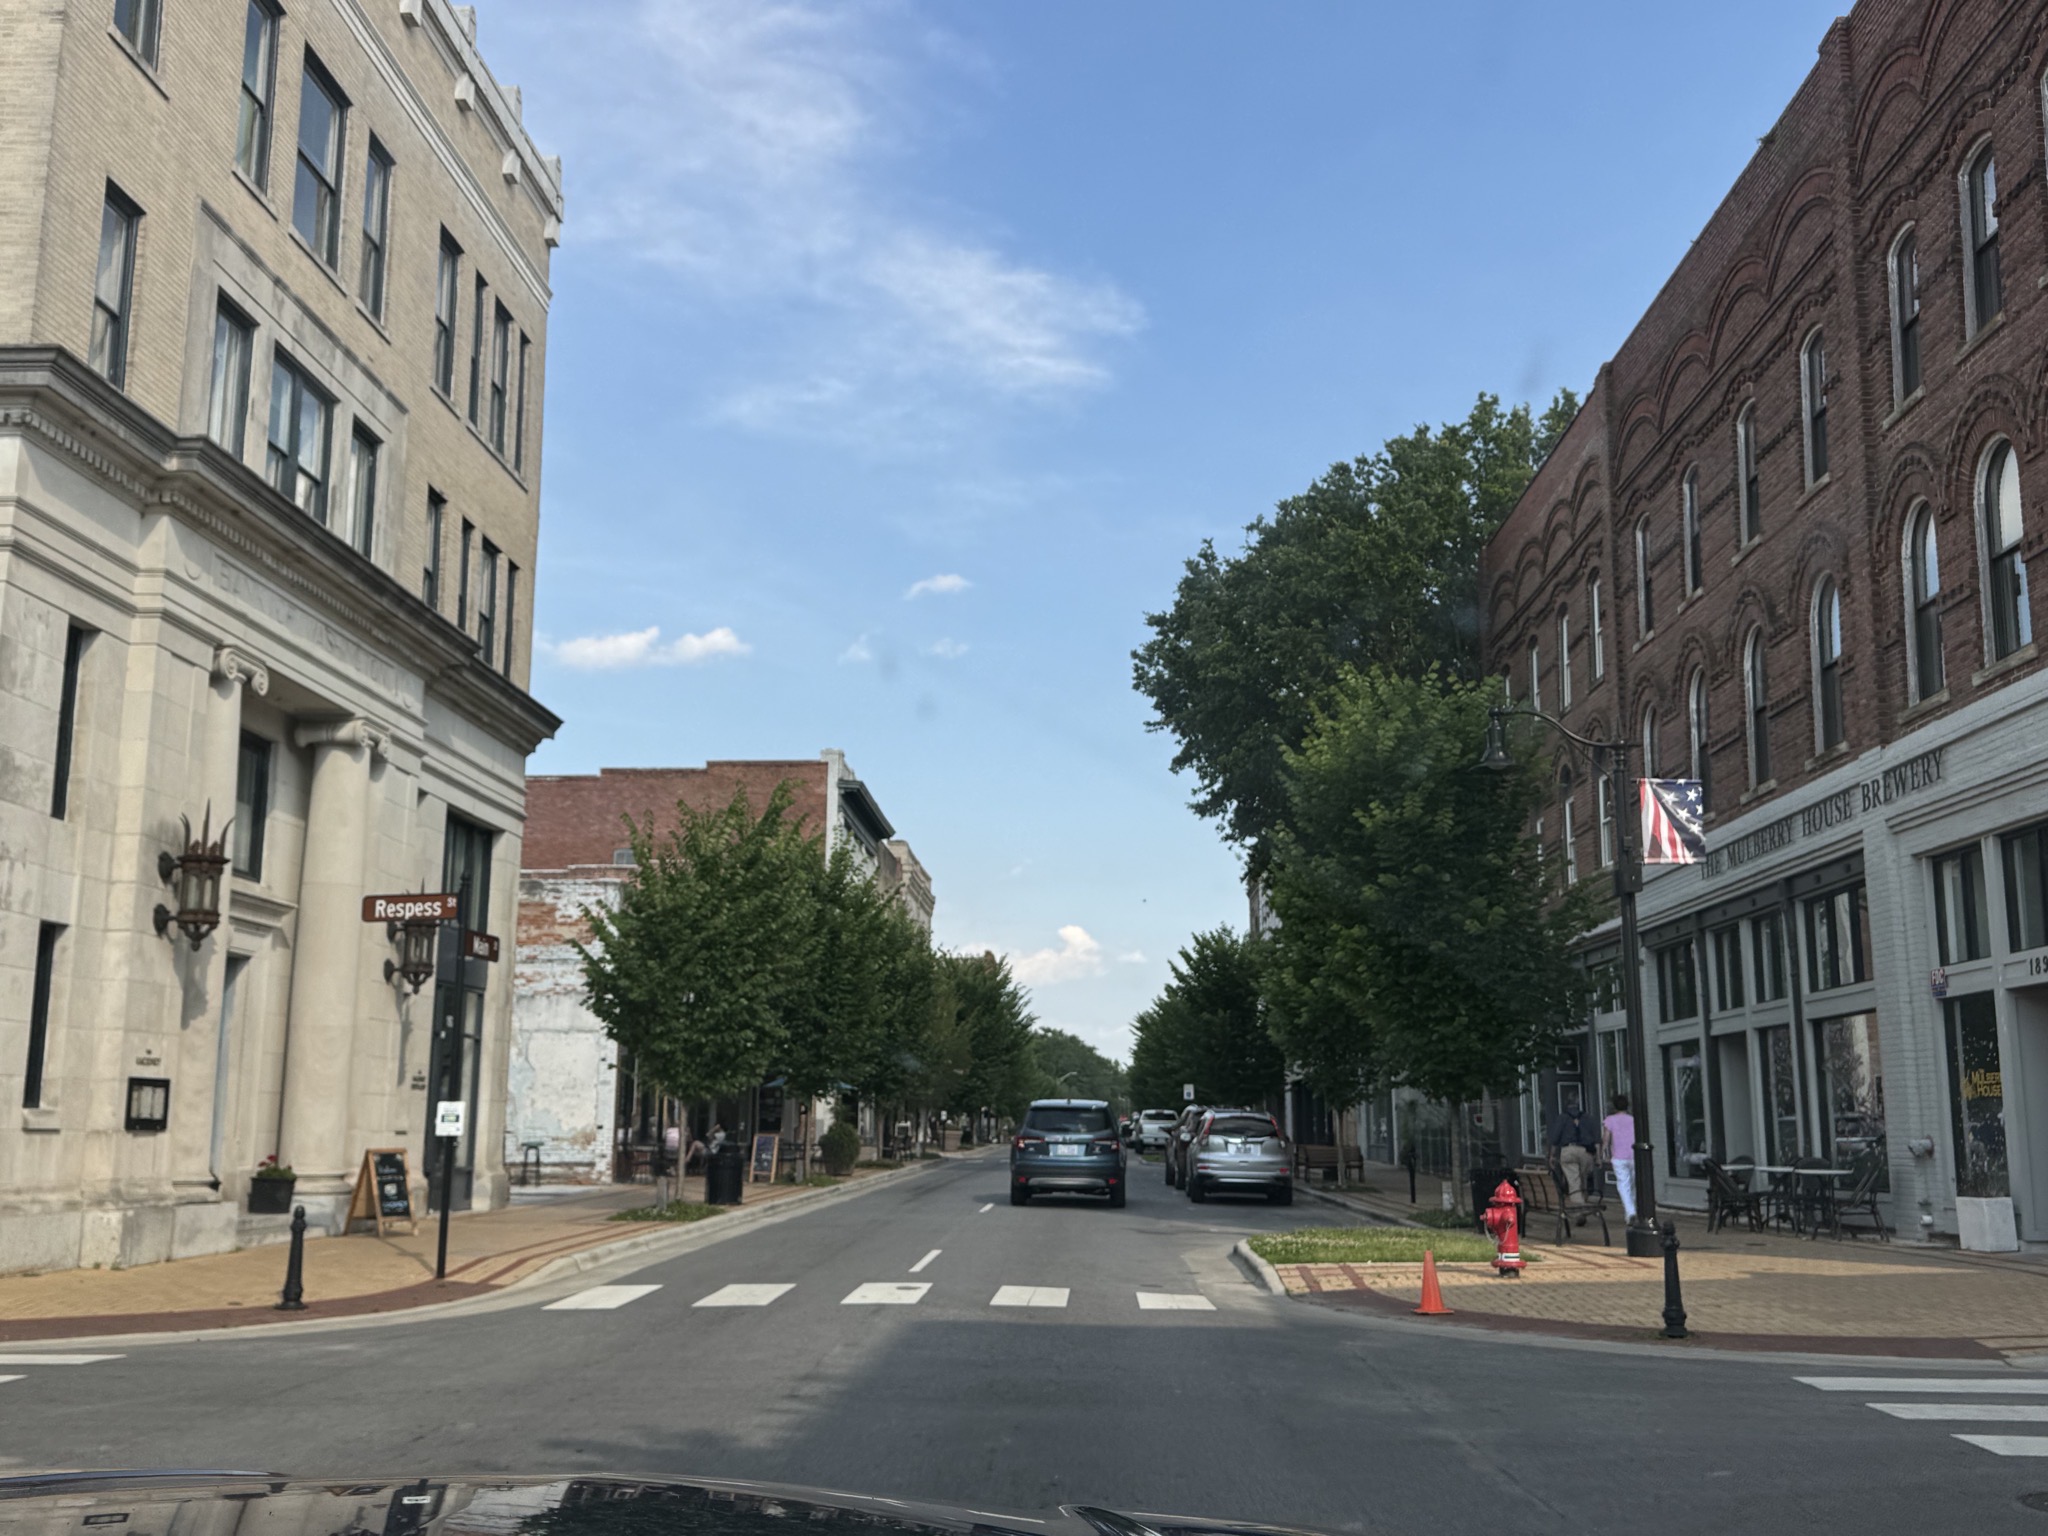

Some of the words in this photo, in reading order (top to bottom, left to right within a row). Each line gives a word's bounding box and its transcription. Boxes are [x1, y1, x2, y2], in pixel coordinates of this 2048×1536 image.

[1726, 816, 1795, 870] MULBERRY
[1801, 790, 1853, 837] HOUSE
[1860, 749, 1945, 813] BREWERY
[374, 899, 442, 920] Respess
[446, 897, 457, 908] St
[473, 935, 489, 956] Main
